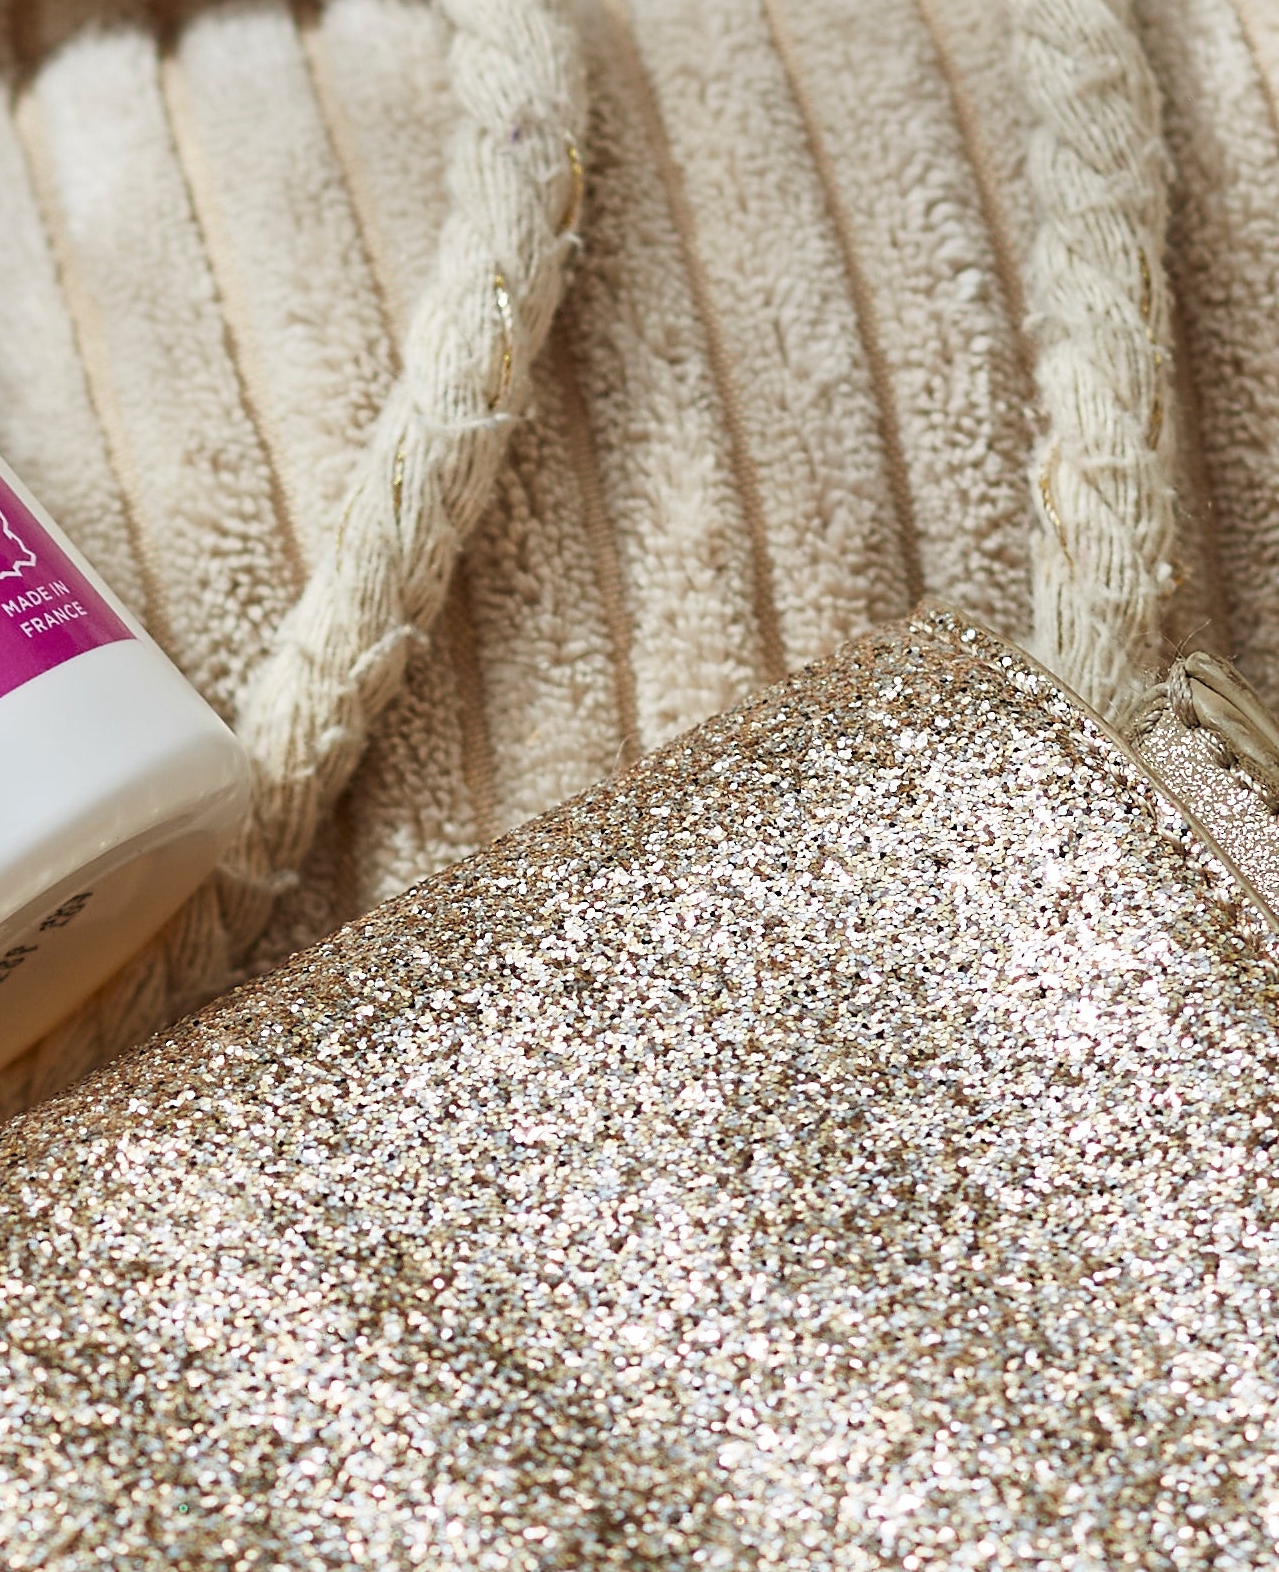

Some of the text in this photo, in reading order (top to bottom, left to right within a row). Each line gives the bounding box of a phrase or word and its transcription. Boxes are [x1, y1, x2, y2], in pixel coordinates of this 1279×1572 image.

[0, 579, 71, 618] MADE IN
[19, 601, 88, 638] FRANCE
